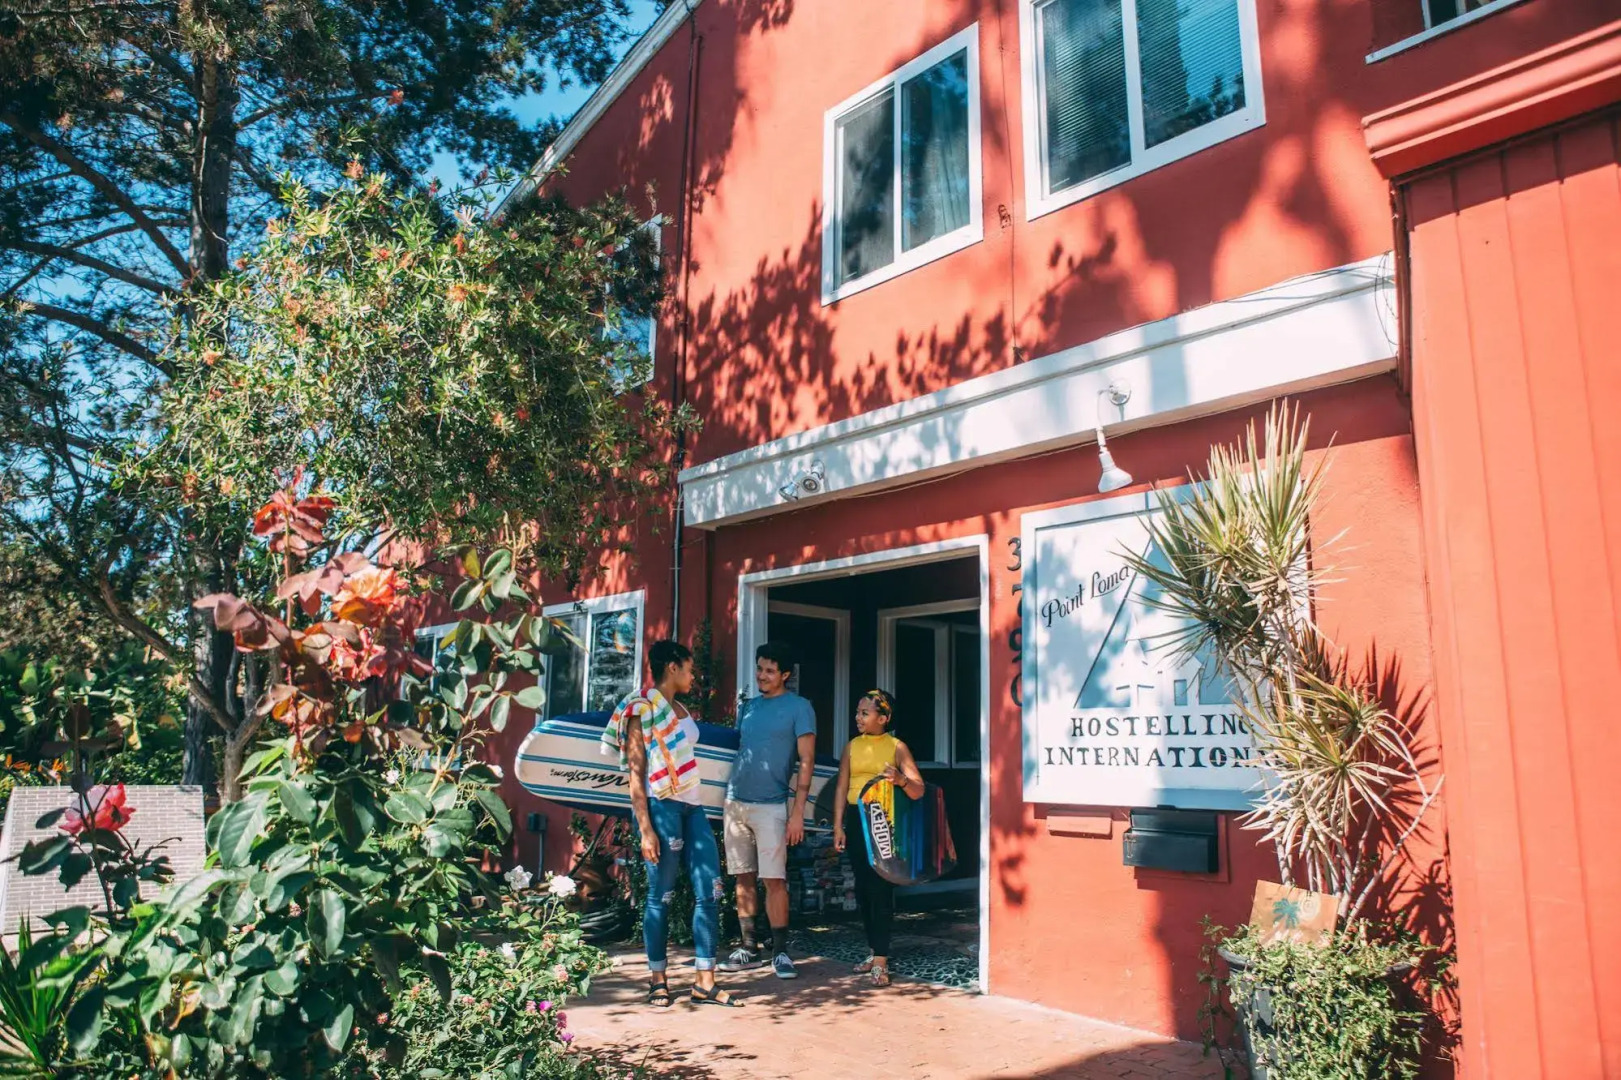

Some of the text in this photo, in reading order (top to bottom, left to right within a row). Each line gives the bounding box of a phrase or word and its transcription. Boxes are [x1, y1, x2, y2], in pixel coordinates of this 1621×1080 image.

[1041, 565, 1130, 628] Point Loma
[1044, 746, 1281, 769] INTERNATION
[871, 804, 891, 858] MOREY
